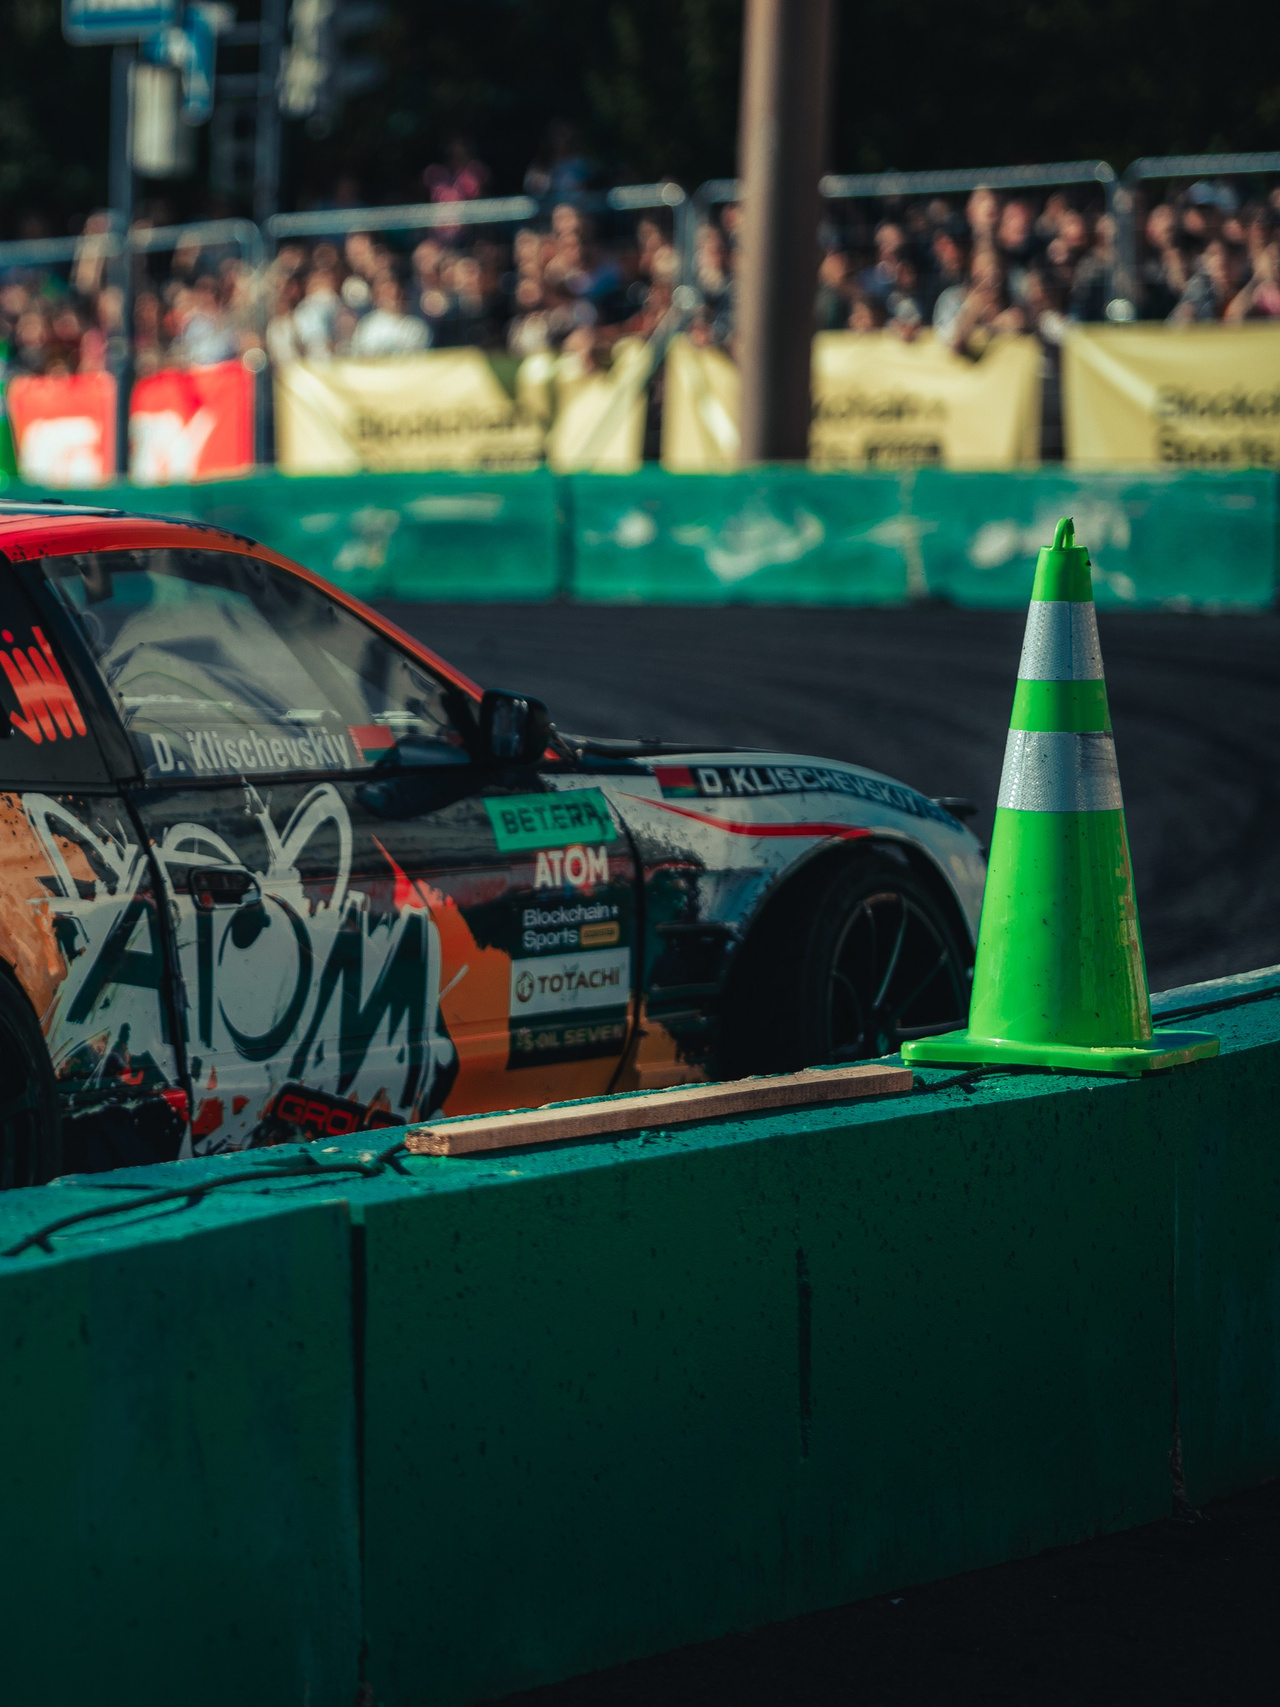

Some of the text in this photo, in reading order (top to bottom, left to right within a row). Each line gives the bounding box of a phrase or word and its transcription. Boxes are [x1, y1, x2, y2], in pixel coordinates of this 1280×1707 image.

[150, 726, 350, 772] D. Klischevskiy
[501, 802, 600, 834] BETERA
[533, 845, 610, 889] ATOM
[523, 902, 610, 926] Blockchain
[524, 928, 579, 950] Sports
[538, 966, 620, 993] TOTACHI
